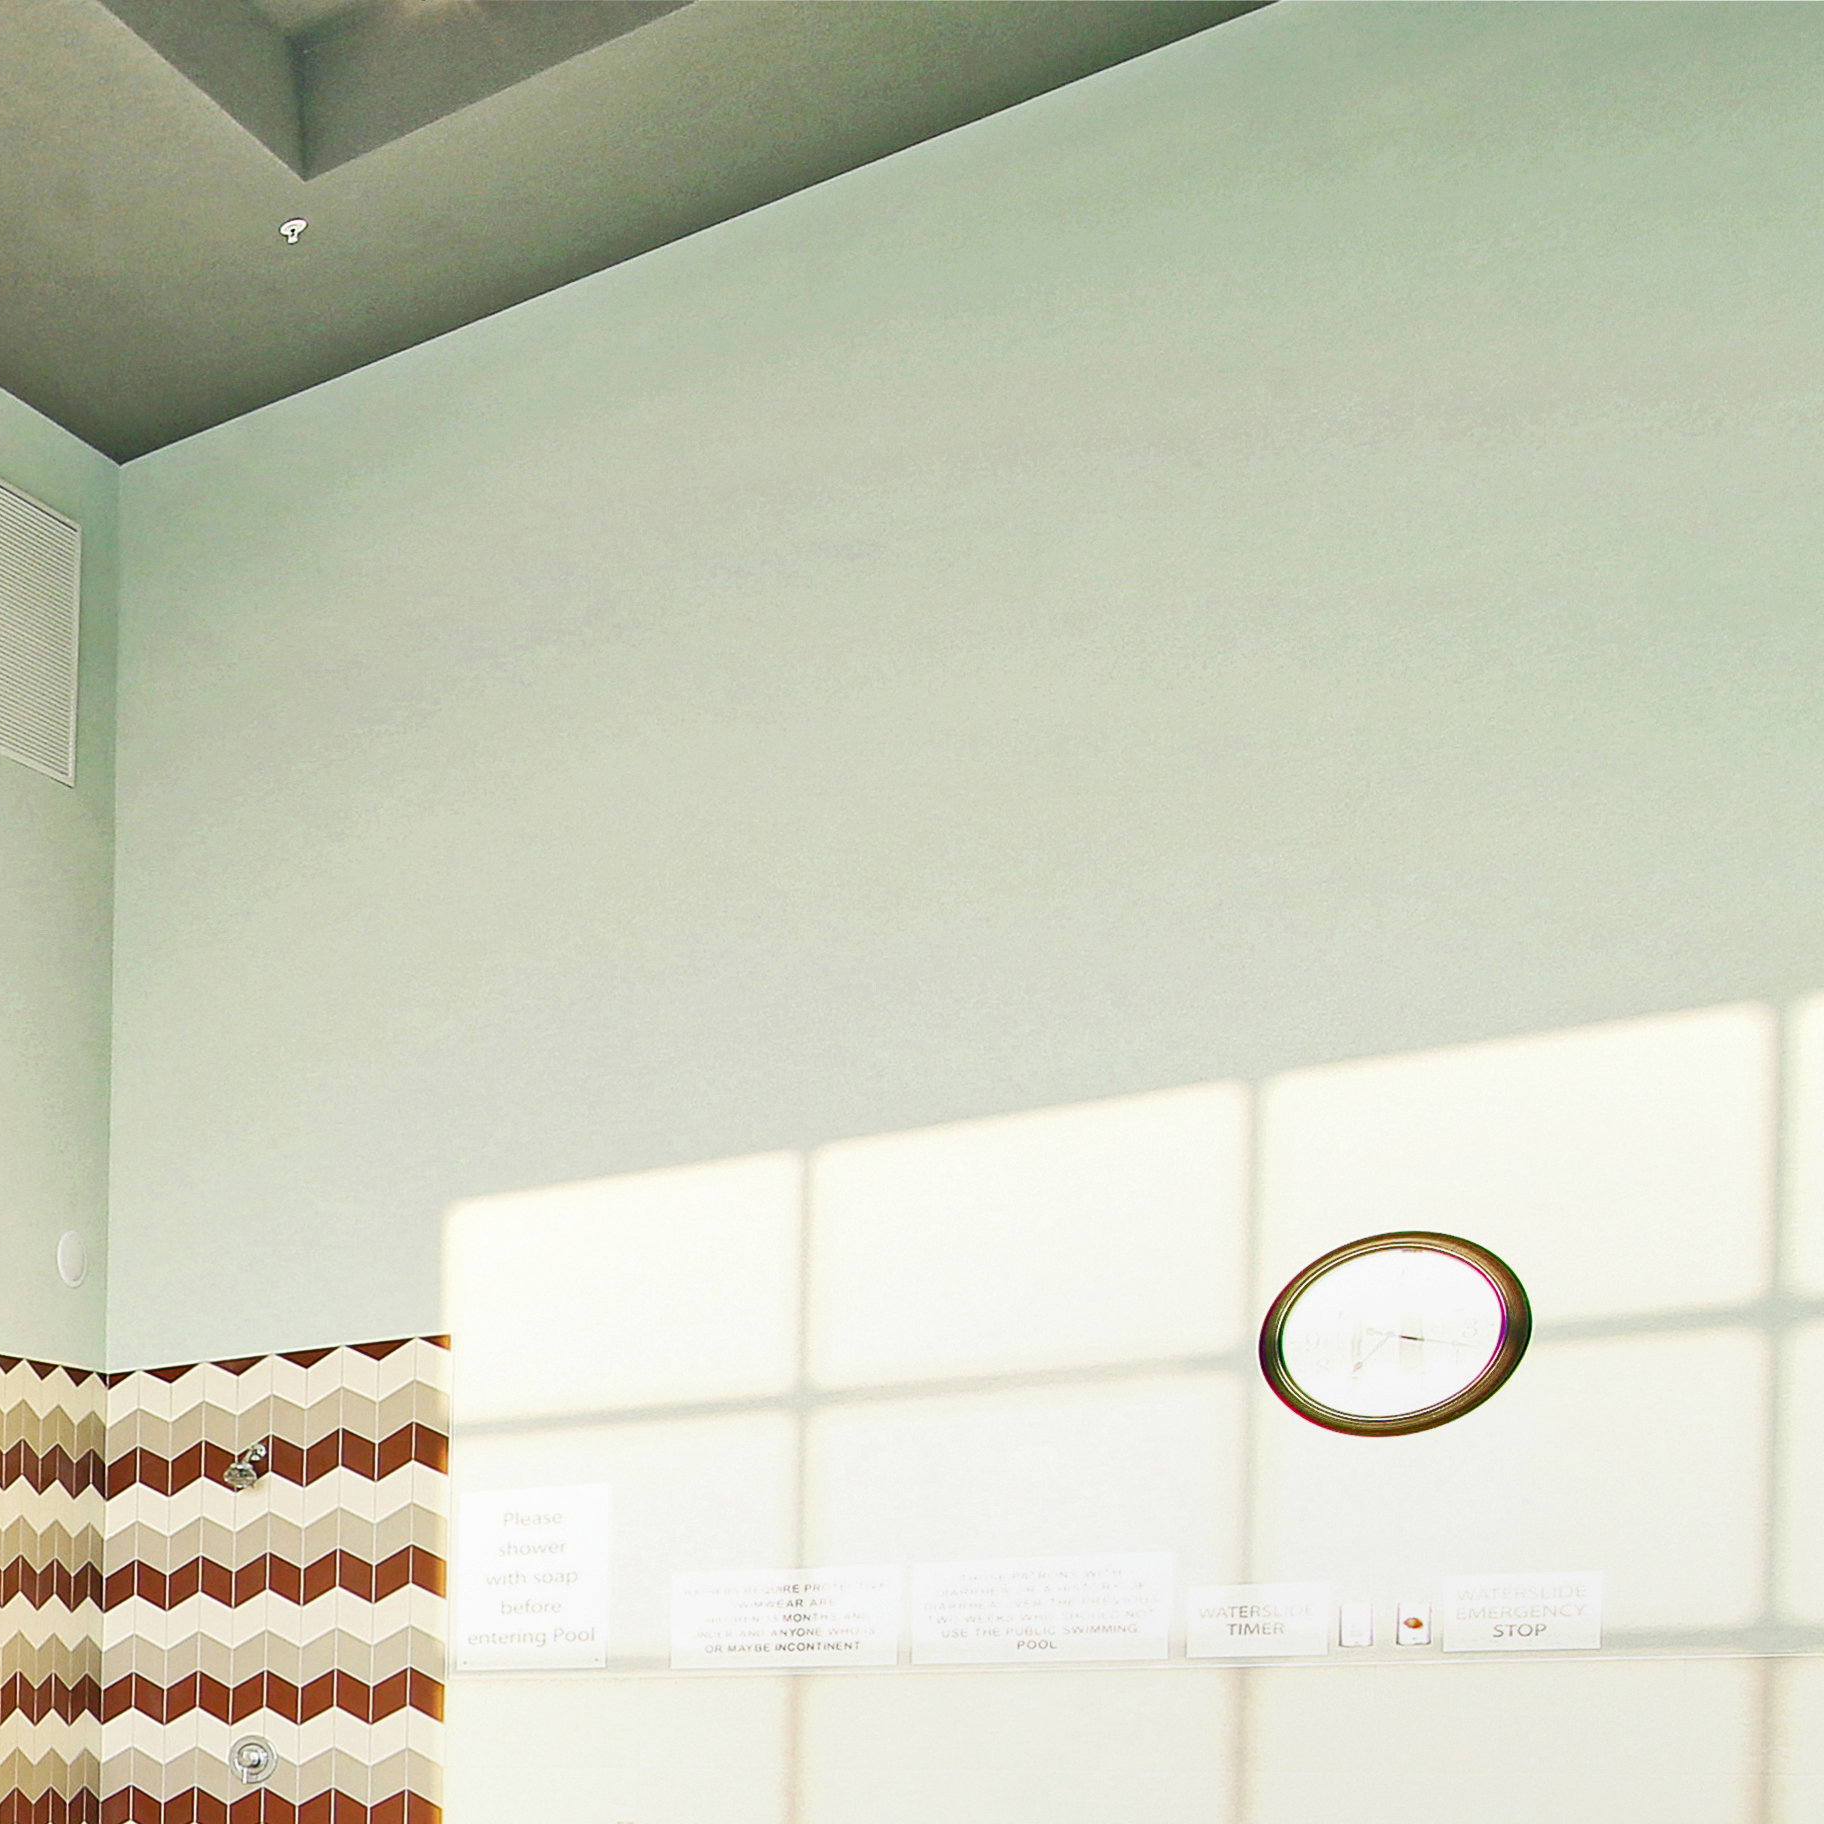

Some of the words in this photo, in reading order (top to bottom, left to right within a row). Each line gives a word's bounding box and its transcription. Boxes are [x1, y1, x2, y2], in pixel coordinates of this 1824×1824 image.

[503, 1511, 563, 1527] Please
[498, 1541, 567, 1557] shower
[486, 1570, 527, 1586] with
[533, 1570, 579, 1587] soap
[1456, 1583, 1587, 1602] WATERSLIDE
[501, 1599, 562, 1616] before
[1198, 1603, 1315, 1620] WATERSLIDE
[1456, 1602, 1586, 1621] EMERGENCY
[467, 1630, 547, 1648] entering
[553, 1626, 595, 1643] Pool
[940, 1628, 969, 1639] USE
[976, 1626, 1001, 1638] THE
[1005, 1625, 1056, 1637] PUBLIC
[1063, 1622, 1138, 1636] SWIMMING
[1225, 1621, 1286, 1638] TIMER
[1491, 1622, 1549, 1640] STOP
[704, 1643, 723, 1655] OR
[727, 1642, 771, 1654] MAYBE
[774, 1639, 861, 1653] INCONTINENT
[1016, 1639, 1058, 1651] POOL
